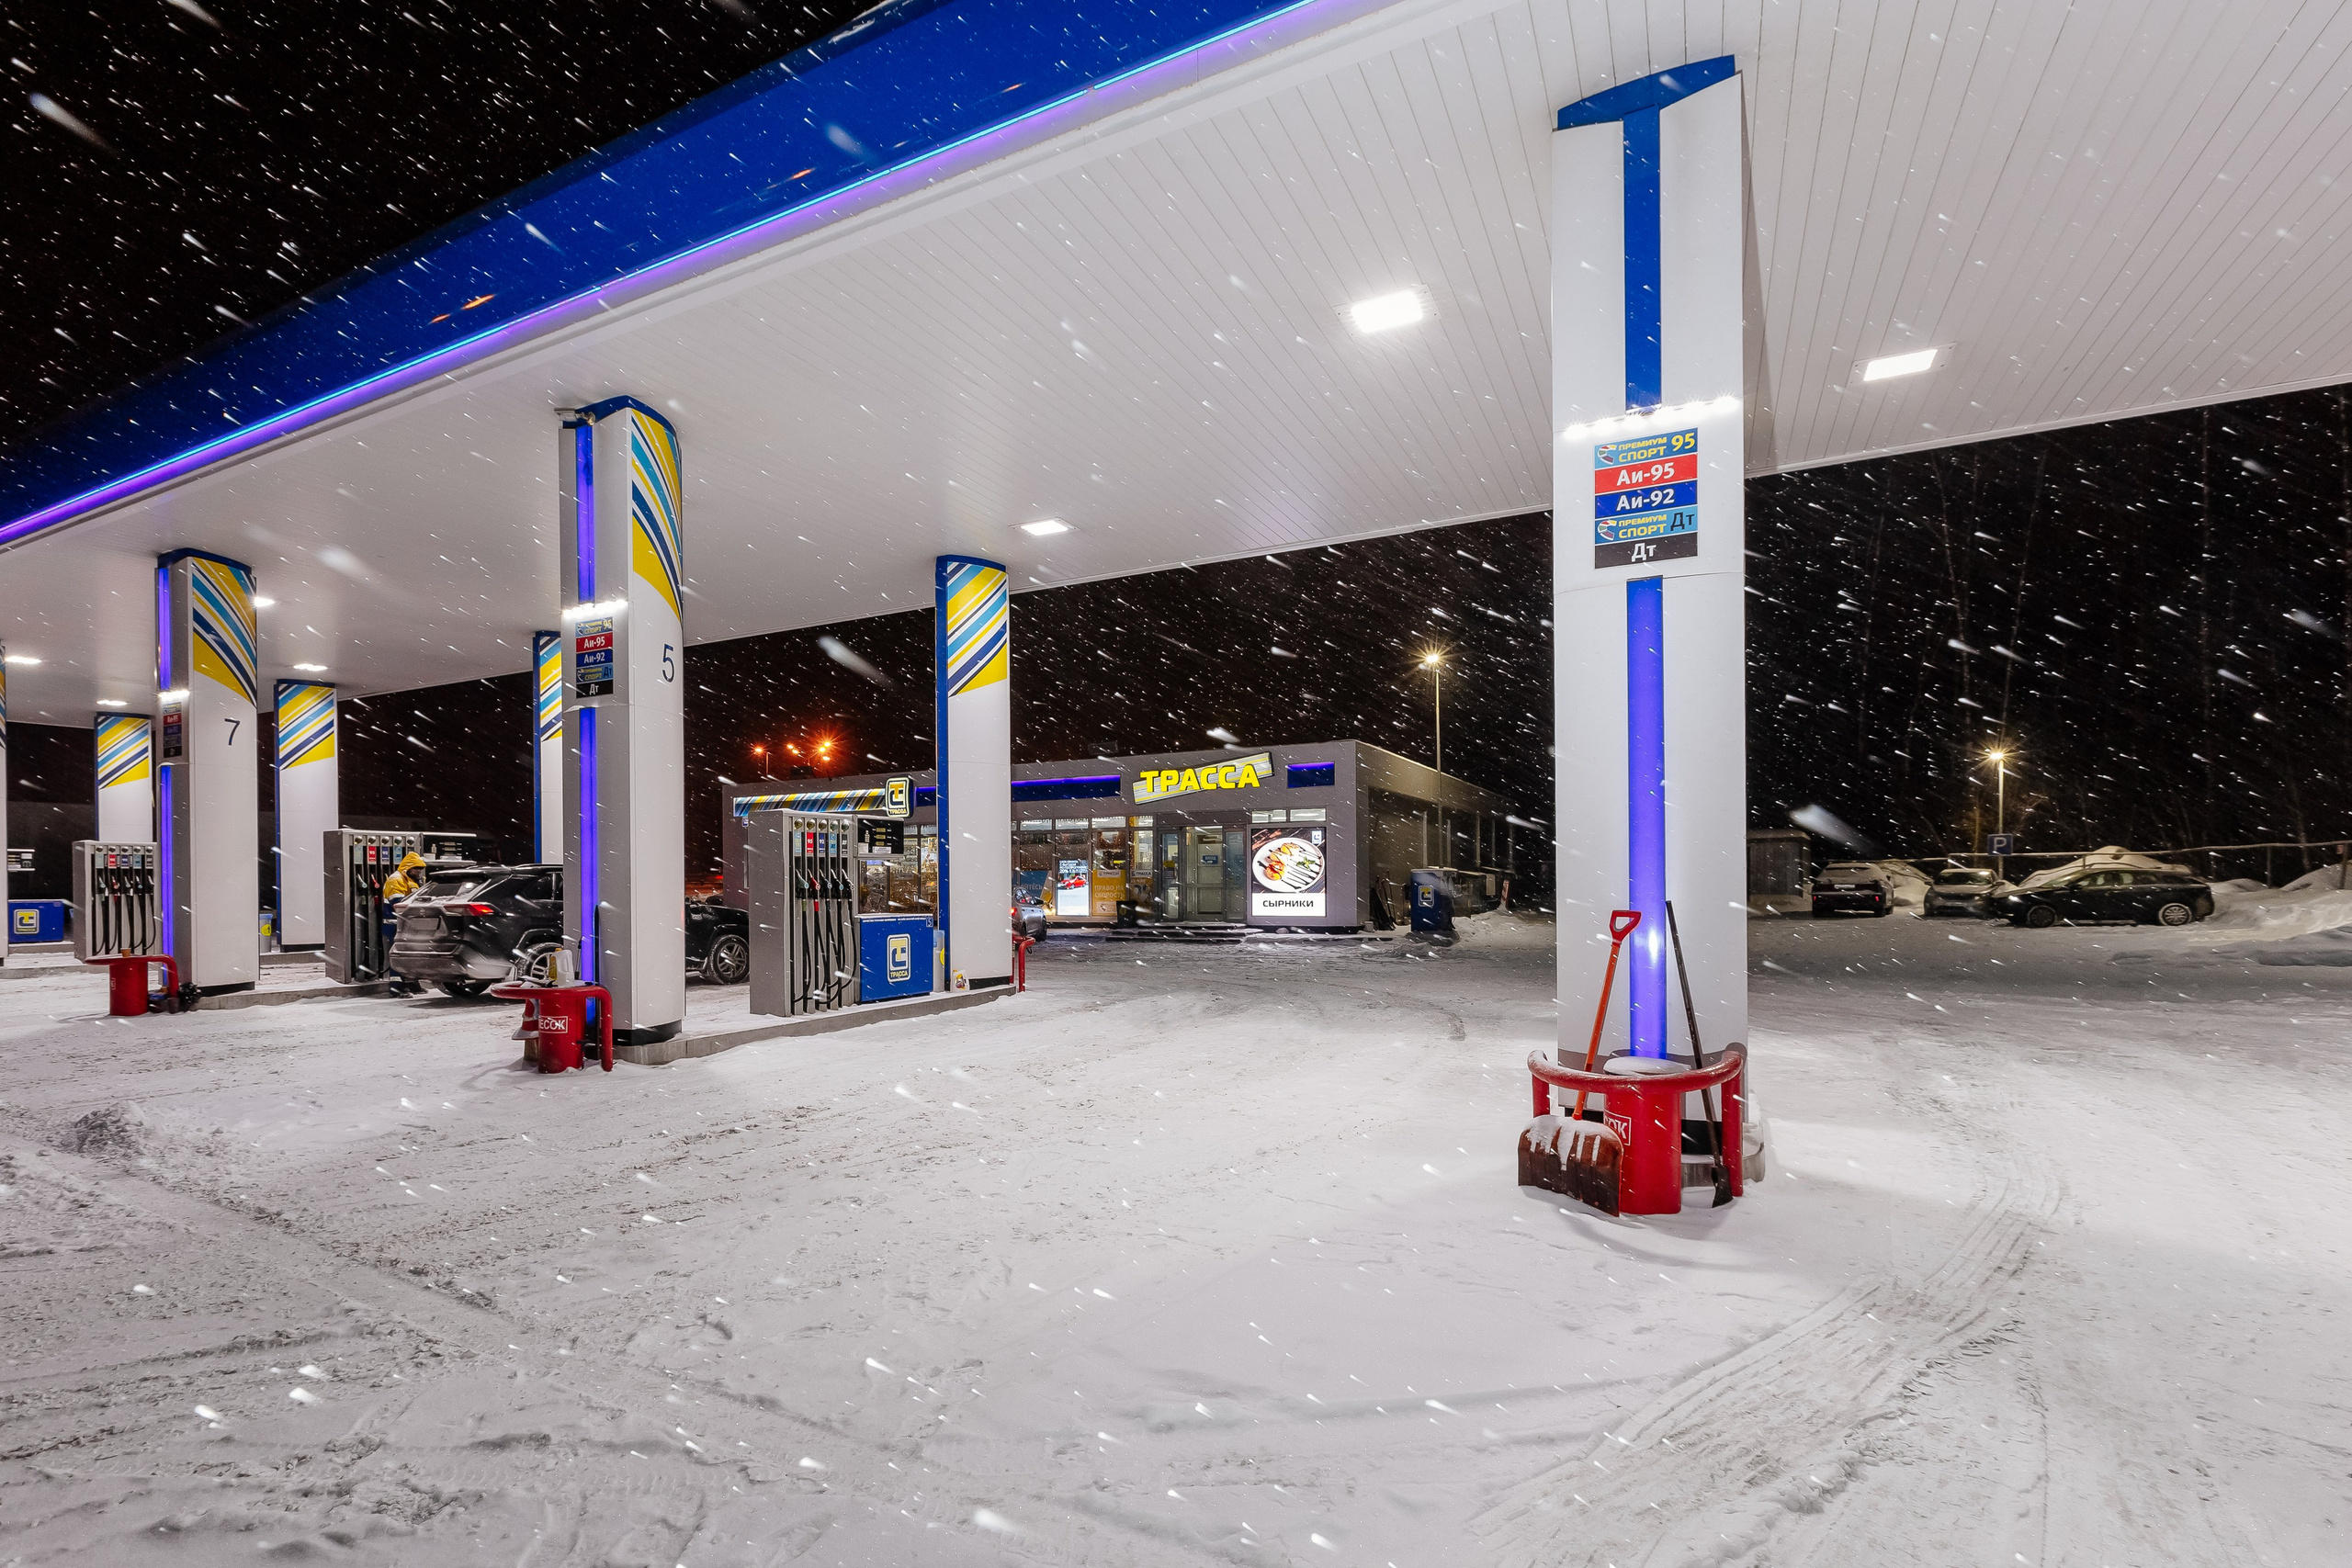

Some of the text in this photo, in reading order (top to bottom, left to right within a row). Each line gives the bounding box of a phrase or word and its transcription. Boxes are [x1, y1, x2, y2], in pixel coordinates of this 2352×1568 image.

[1618, 432, 1695, 452] ПРЕМИУМ 95
[1619, 446, 1667, 462] СПОРТ
[1616, 462, 1675, 486] Аи-95
[1616, 488, 1675, 511] Аи-92
[1618, 512, 1695, 531] ПРЕМИУМ Дт
[1619, 524, 1667, 539] СПОРТ
[1631, 542, 1657, 562] Дт
[584, 626, 602, 635] СПОРТ
[603, 619, 612, 630] 95
[583, 636, 605, 649] Аи-95
[583, 651, 605, 664] Аи-92
[662, 643, 674, 683] 5
[589, 683, 599, 695] Дт
[224, 718, 240, 746] 7
[1140, 764, 1260, 793] ТРАССА
[1994, 837, 2007, 852] P
[1262, 899, 1314, 908] СЫРНИКИ
[890, 970, 909, 978] ТРАССА
[538, 1019, 565, 1030] ЕСОК
